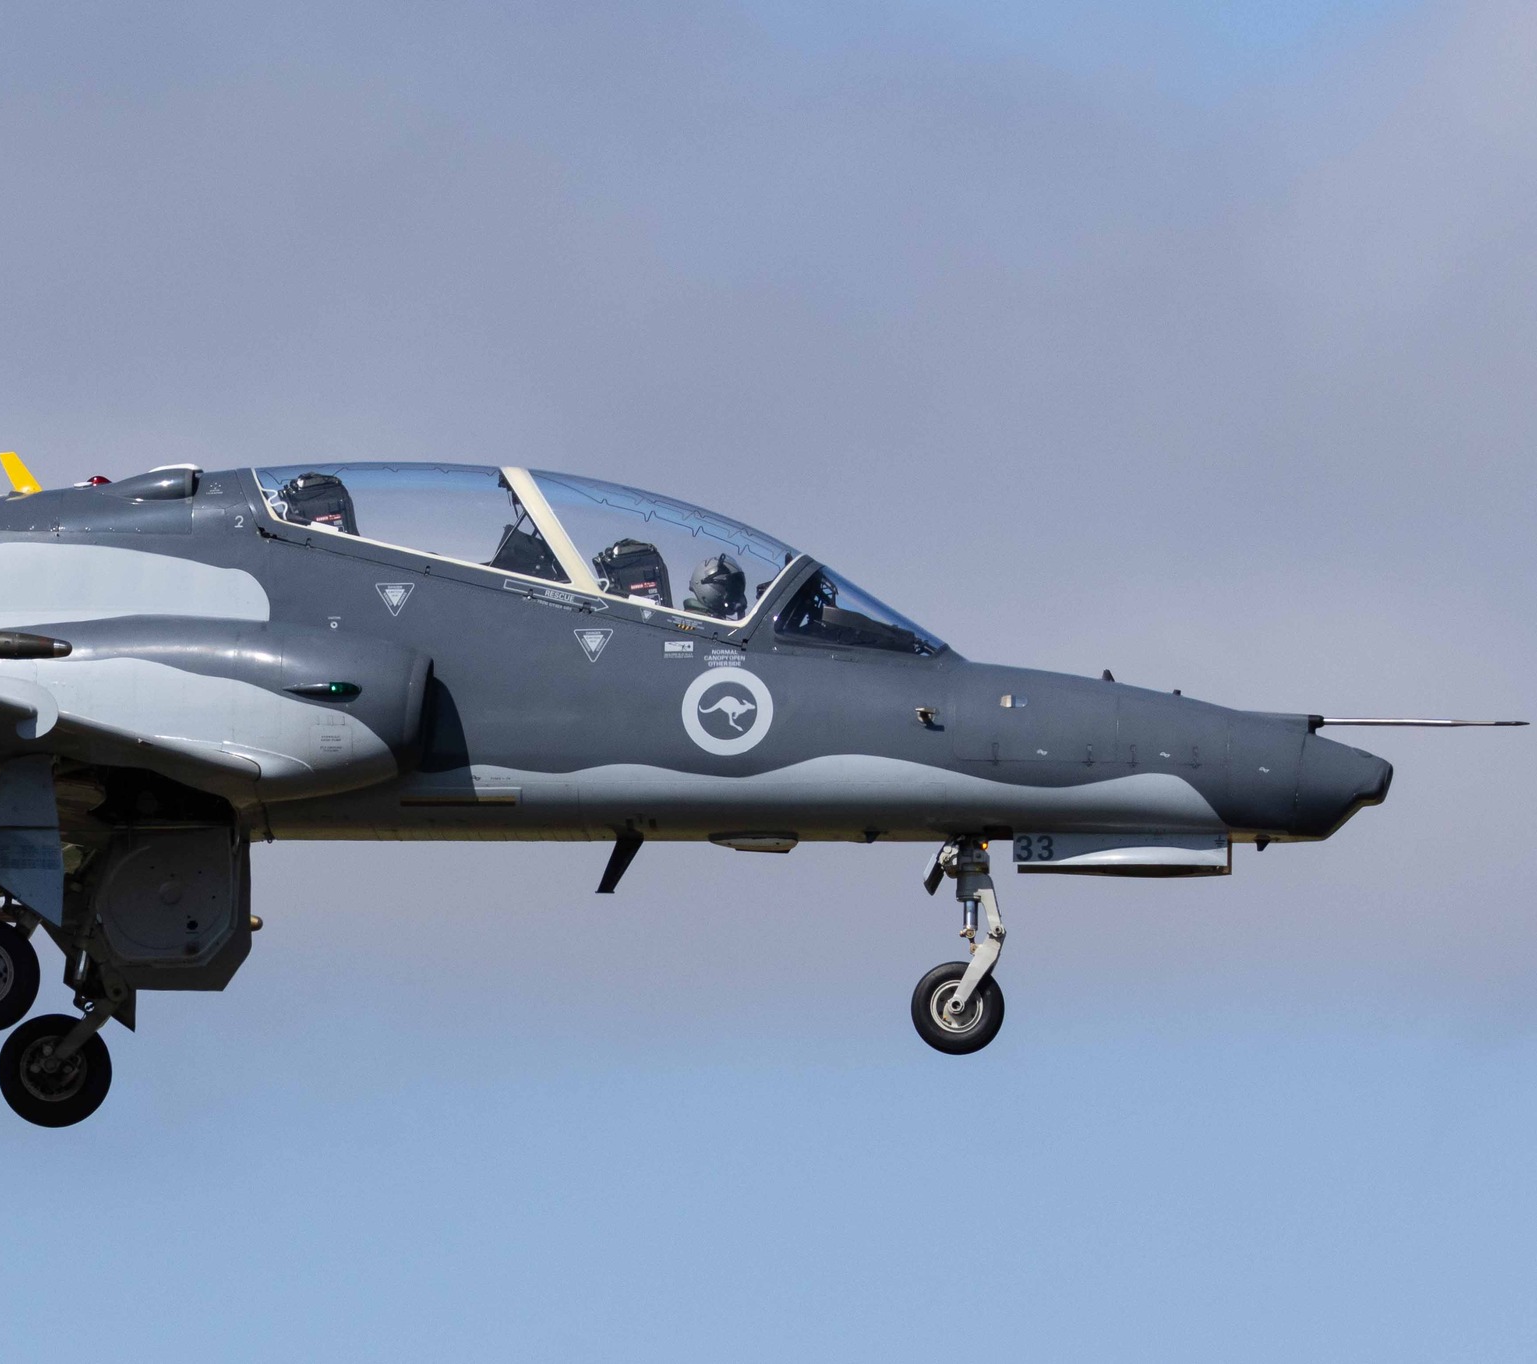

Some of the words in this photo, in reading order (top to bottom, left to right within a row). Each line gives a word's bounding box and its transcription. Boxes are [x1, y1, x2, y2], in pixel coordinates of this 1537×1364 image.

[234, 515, 244, 528] 2
[544, 590, 575, 603] RESCUE
[1016, 835, 1054, 861] 33
